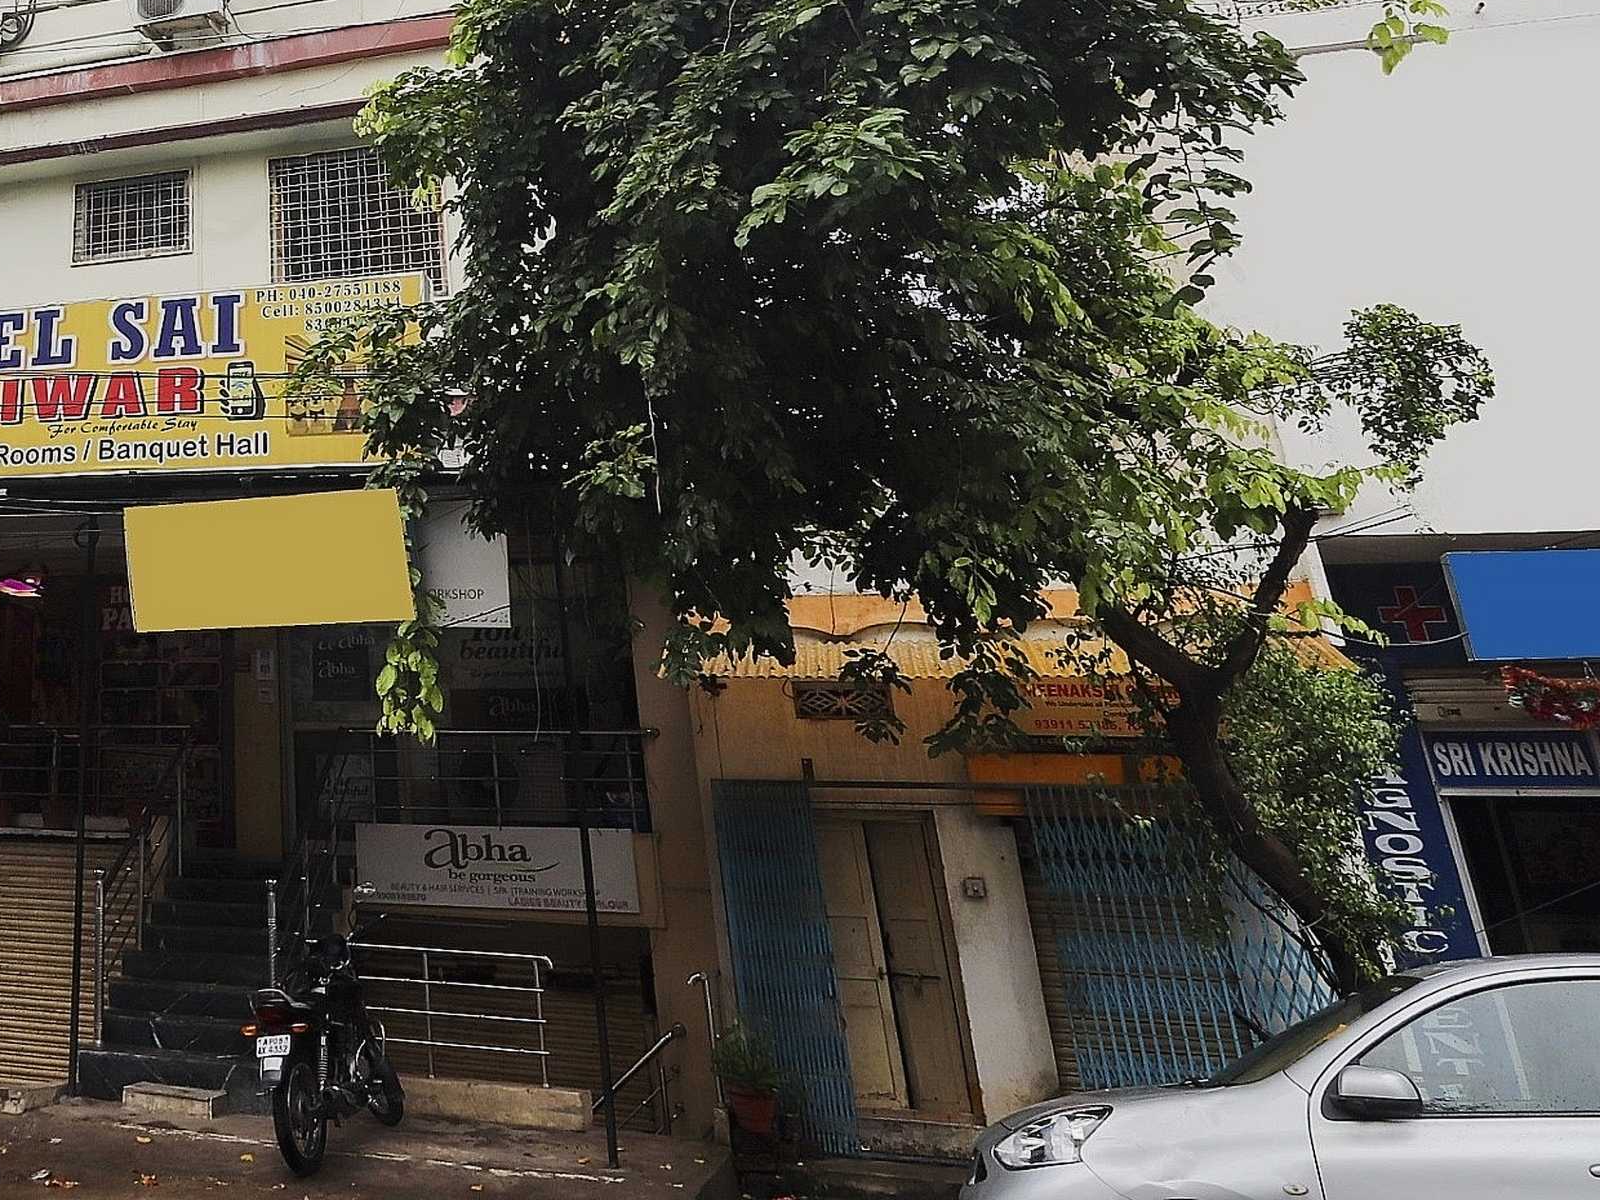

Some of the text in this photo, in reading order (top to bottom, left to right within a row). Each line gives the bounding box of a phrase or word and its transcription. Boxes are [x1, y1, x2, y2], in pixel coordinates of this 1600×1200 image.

[256, 280, 401, 303] PH: 040-27551188
[262, 304, 300, 318] Cell:
[111, 294, 242, 361] SAI
[48, 417, 198, 439] For Comfortable Stay
[99, 435, 209, 464] Banquet
[216, 432, 269, 456] Hall
[426, 588, 485, 601] ORKSHOP
[1432, 741, 1594, 777] SRI KRISHNA
[449, 868, 536, 885] be gorgeous
